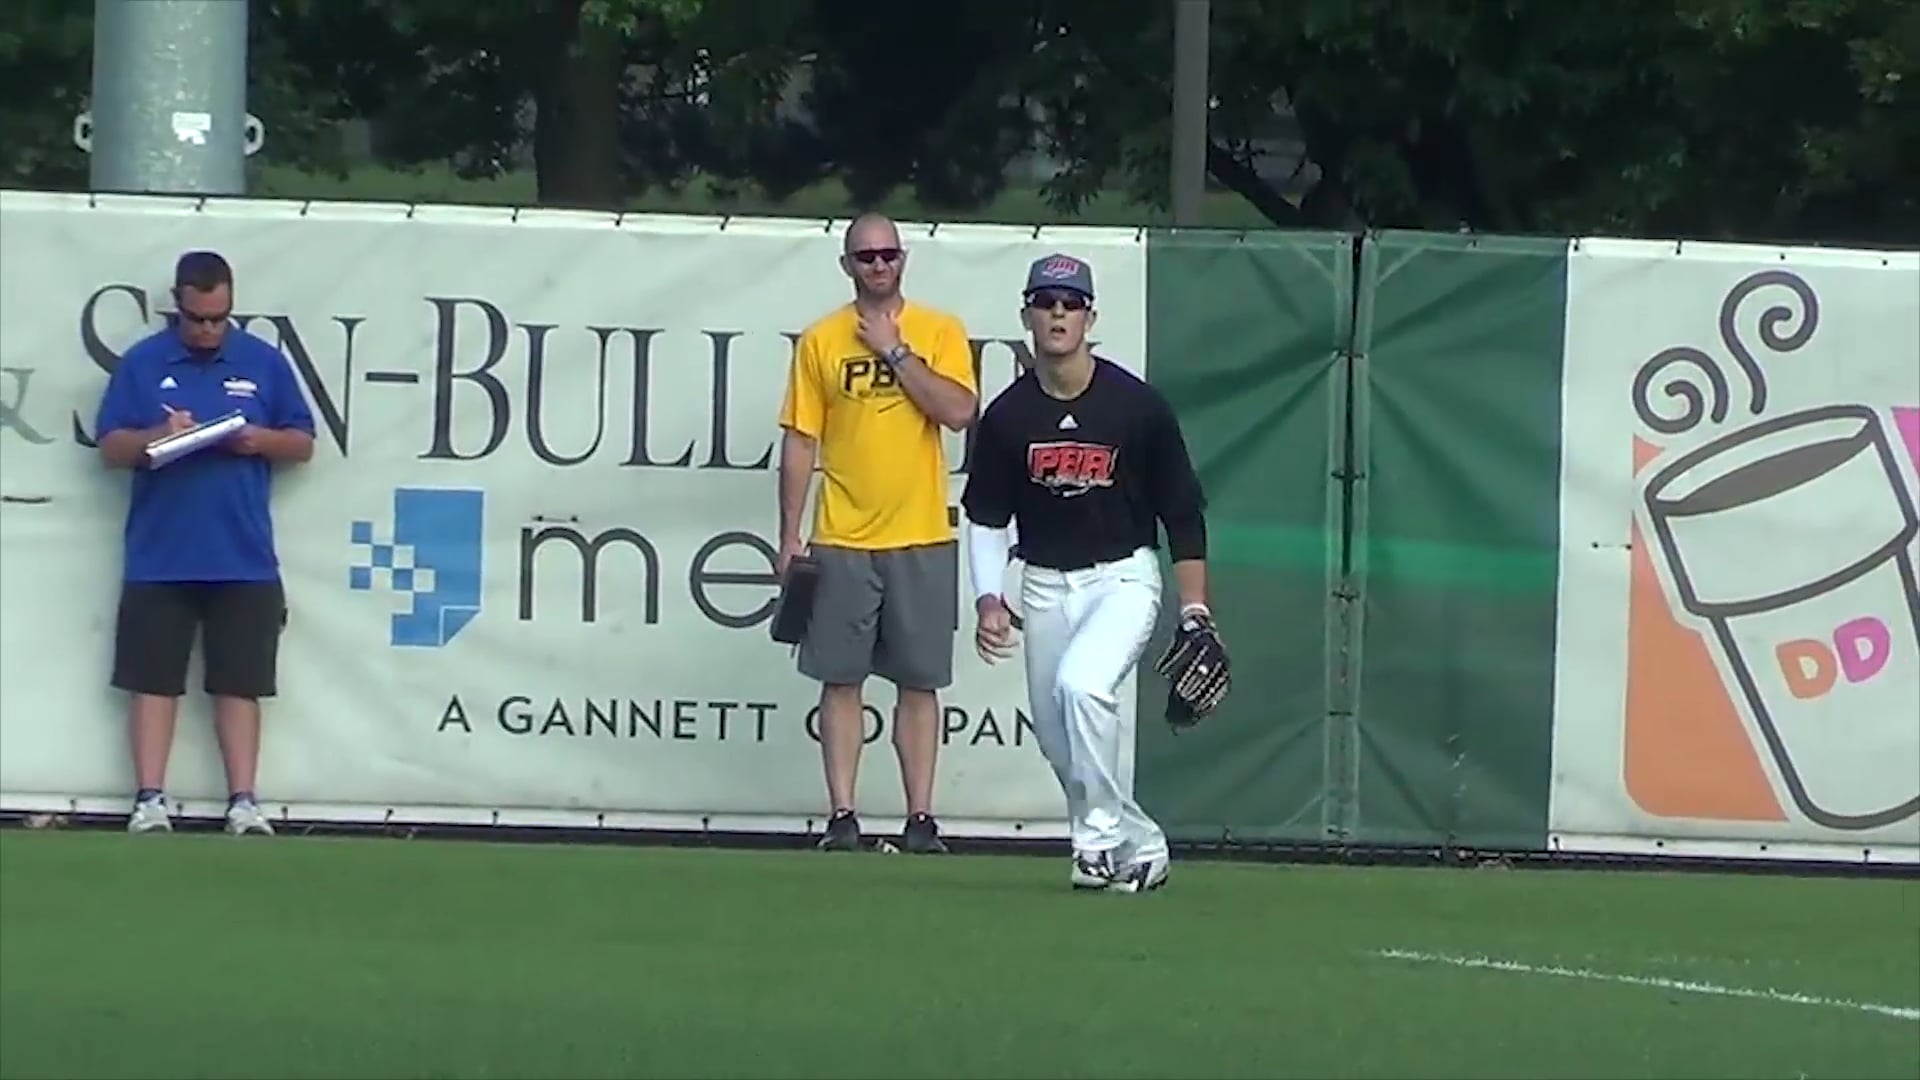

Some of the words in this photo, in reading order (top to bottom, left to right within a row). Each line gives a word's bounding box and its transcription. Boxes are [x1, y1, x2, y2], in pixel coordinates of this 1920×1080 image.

[73, 284, 1101, 473] SN-BULL
[845, 358, 927, 391] PB
[437, 694, 472, 733] A
[497, 696, 778, 742] GANNETT
[805, 704, 1034, 747] COPAN
